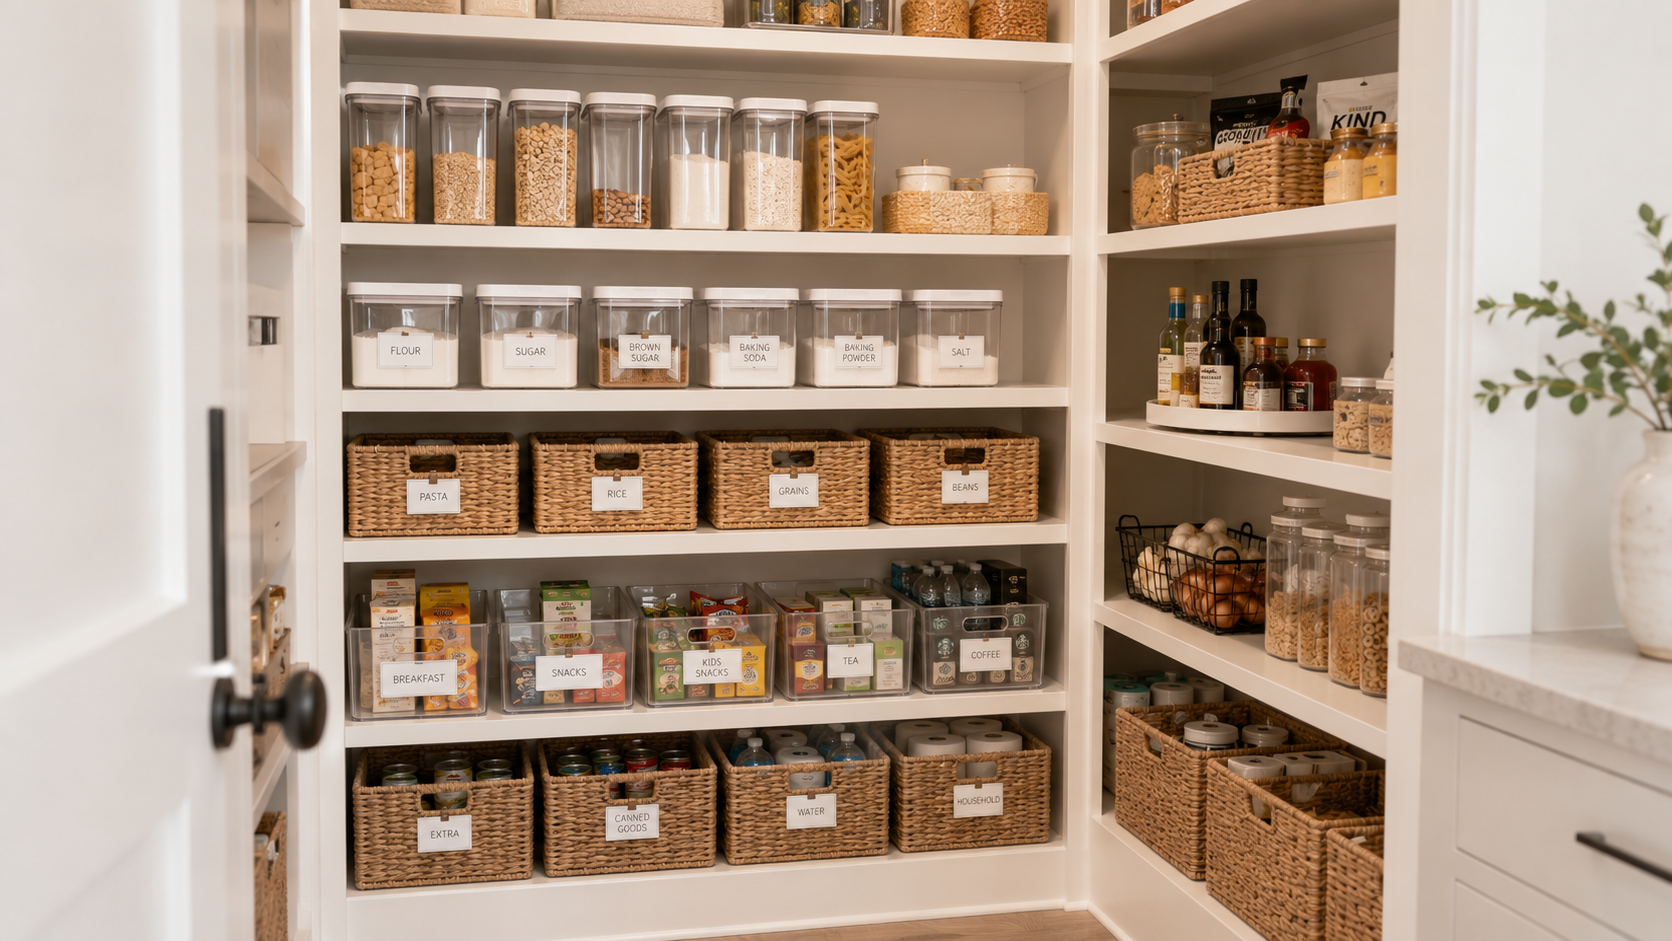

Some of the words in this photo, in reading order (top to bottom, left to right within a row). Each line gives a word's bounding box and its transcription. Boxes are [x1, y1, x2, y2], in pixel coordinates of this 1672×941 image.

[1331, 111, 1386, 130] KIND
[390, 346, 421, 356] FLOUR
[515, 346, 546, 356] SUGAR
[629, 342, 661, 352] BROWN
[739, 343, 771, 352] BAKING
[844, 343, 875, 352] BAKING
[951, 347, 971, 357] SALT
[631, 353, 660, 363] SUGAR
[743, 353, 767, 363] SODA
[842, 353, 876, 363] POWDER
[778, 486, 810, 496] GRAINS
[952, 482, 979, 492] BEANS
[419, 492, 448, 502] PASTA
[607, 489, 627, 499] RICE
[970, 649, 1001, 660] COFFEE
[702, 657, 722, 667] KIDS
[842, 656, 859, 665] TEA
[551, 667, 587, 678] SNACKS
[695, 667, 729, 678] SNACKS
[393, 673, 446, 685] BREAKFAST
[957, 795, 1001, 806] HOUSEHOLD
[797, 806, 825, 817] WATER
[614, 812, 650, 823] CANNED
[617, 823, 648, 834] GOODS
[430, 829, 460, 840] EXTRA
